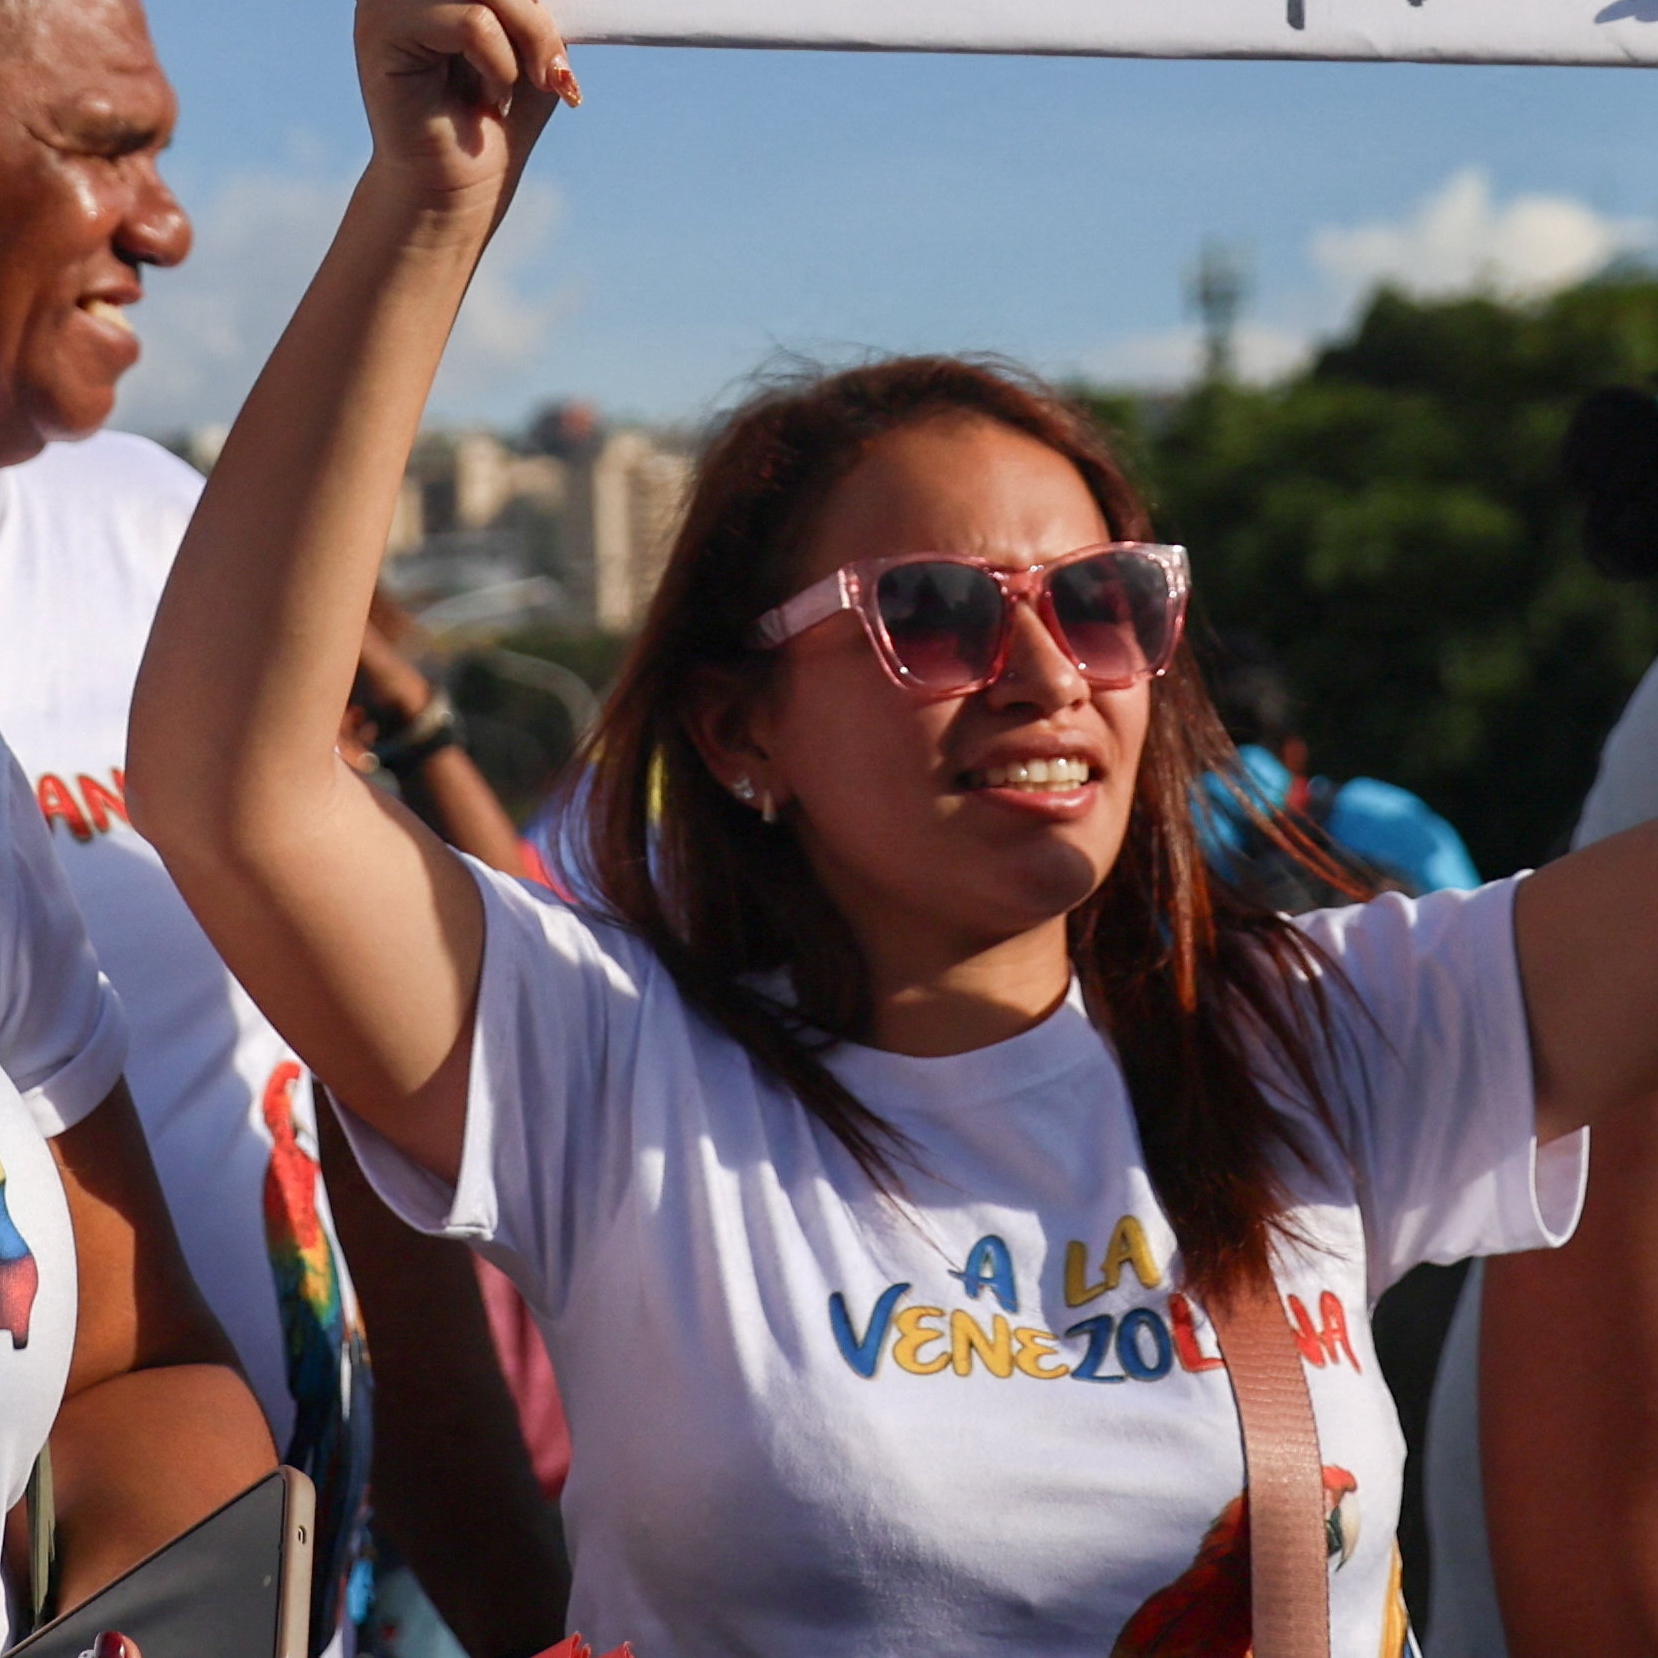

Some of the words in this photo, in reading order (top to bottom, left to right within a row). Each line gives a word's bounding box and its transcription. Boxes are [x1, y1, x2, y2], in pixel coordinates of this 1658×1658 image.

[948, 1233, 1019, 1314] A
[1063, 1215, 1162, 1309] LA
[828, 1282, 1362, 1383] VENEZOLNA
